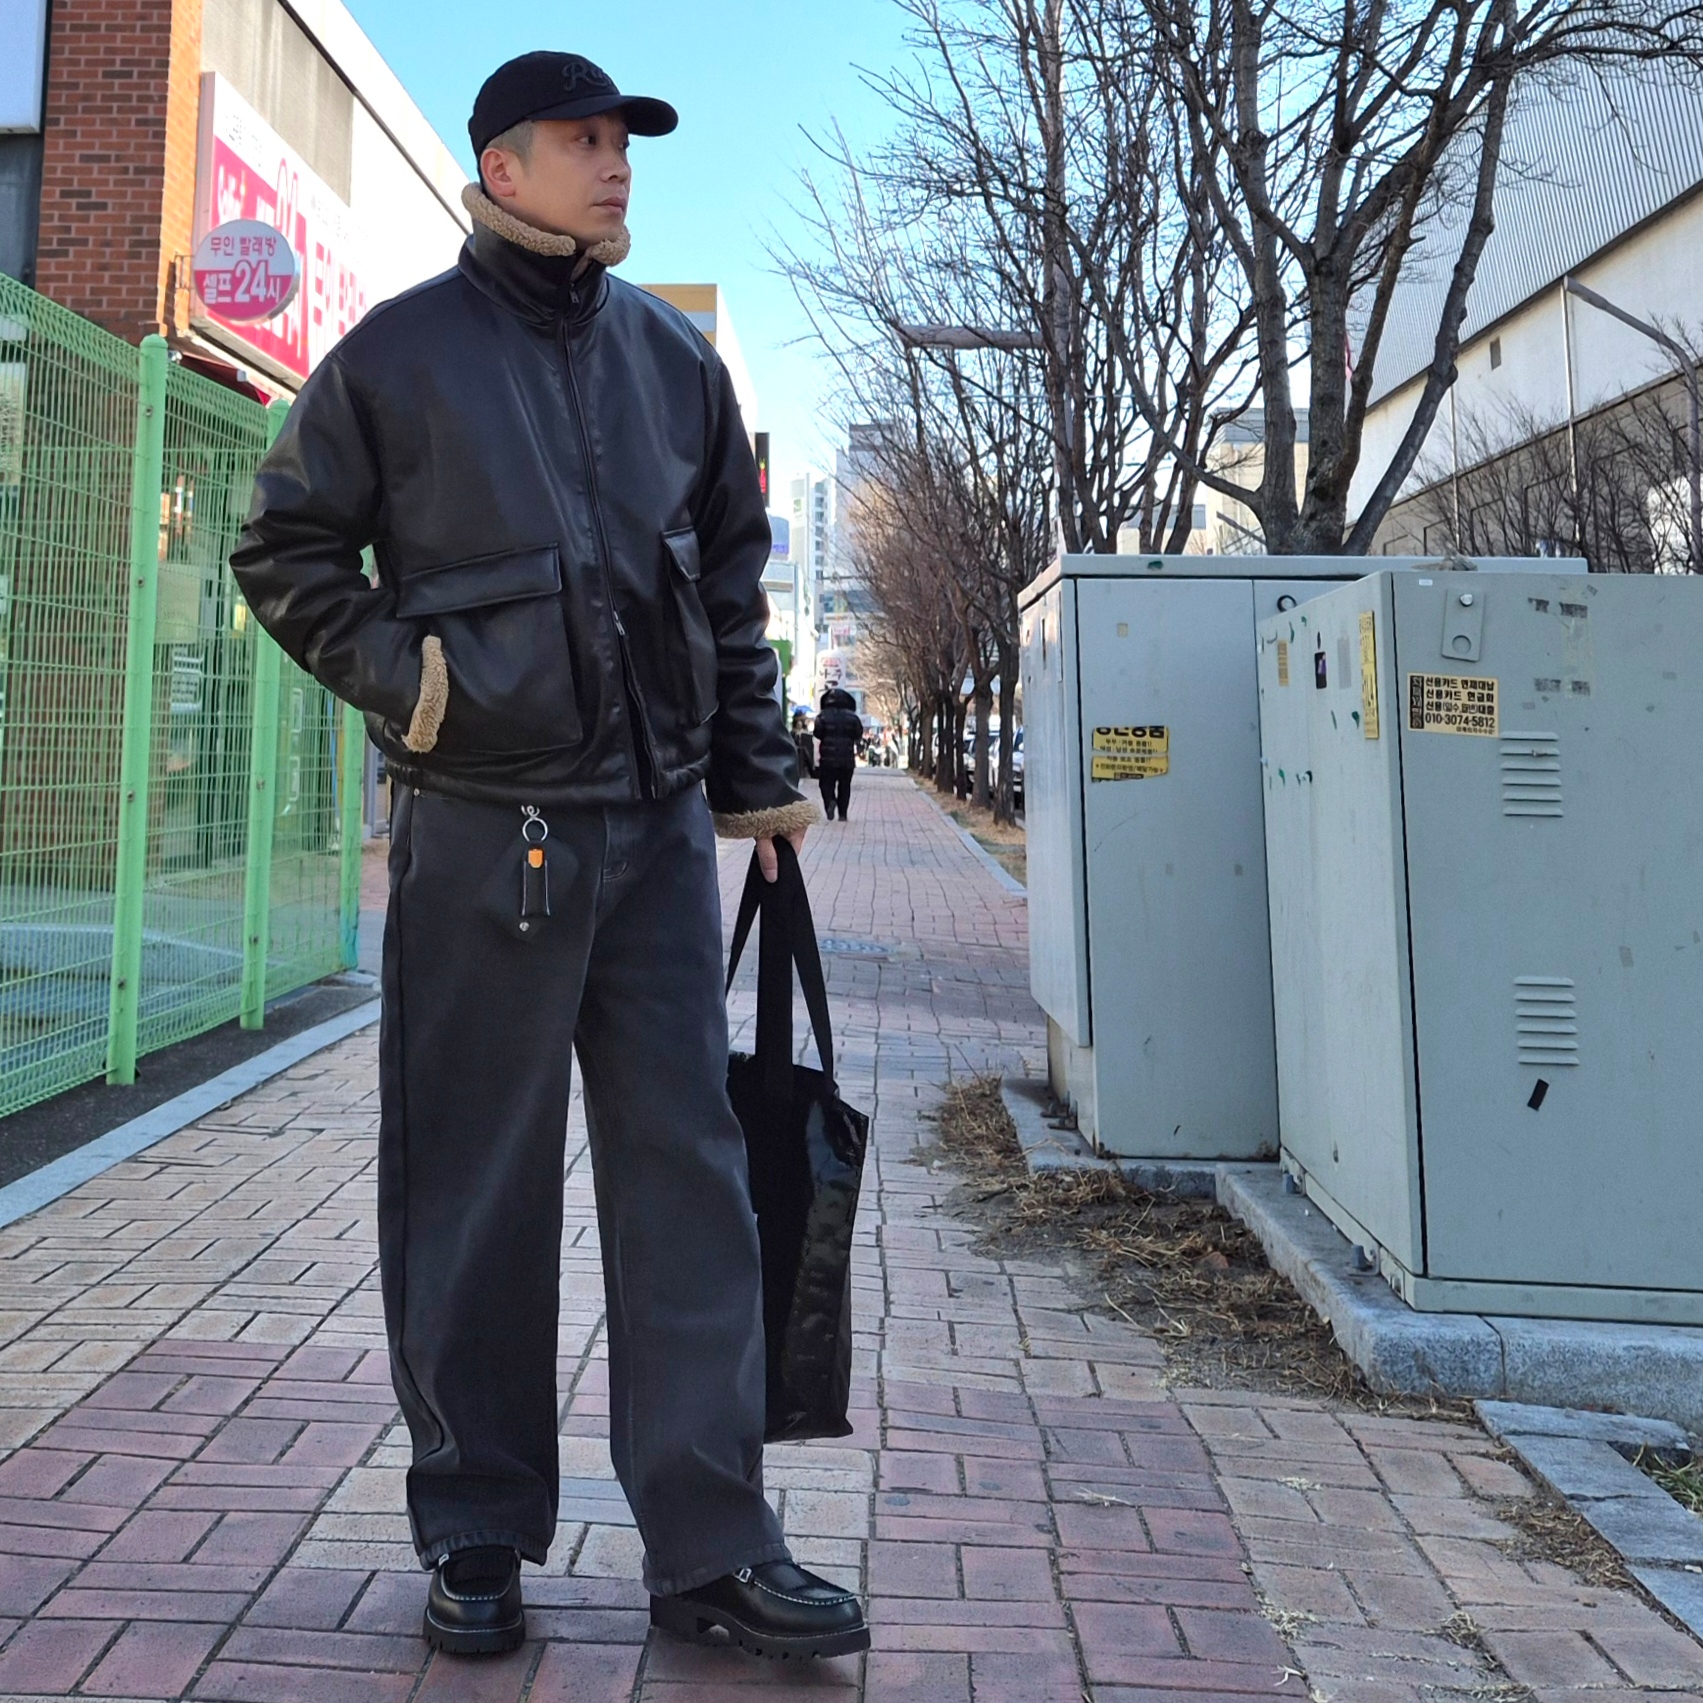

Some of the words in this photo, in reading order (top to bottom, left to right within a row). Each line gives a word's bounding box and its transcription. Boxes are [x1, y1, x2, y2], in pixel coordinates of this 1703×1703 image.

[210, 236, 234, 257] 무인
[239, 236, 277, 257] 빨래방
[1426, 677, 1458, 689] 신용카드
[1426, 689, 1462, 701] 신용카드
[1467, 691, 1494, 703] 현금화
[1425, 712, 1495, 728] 010-3074-5812
